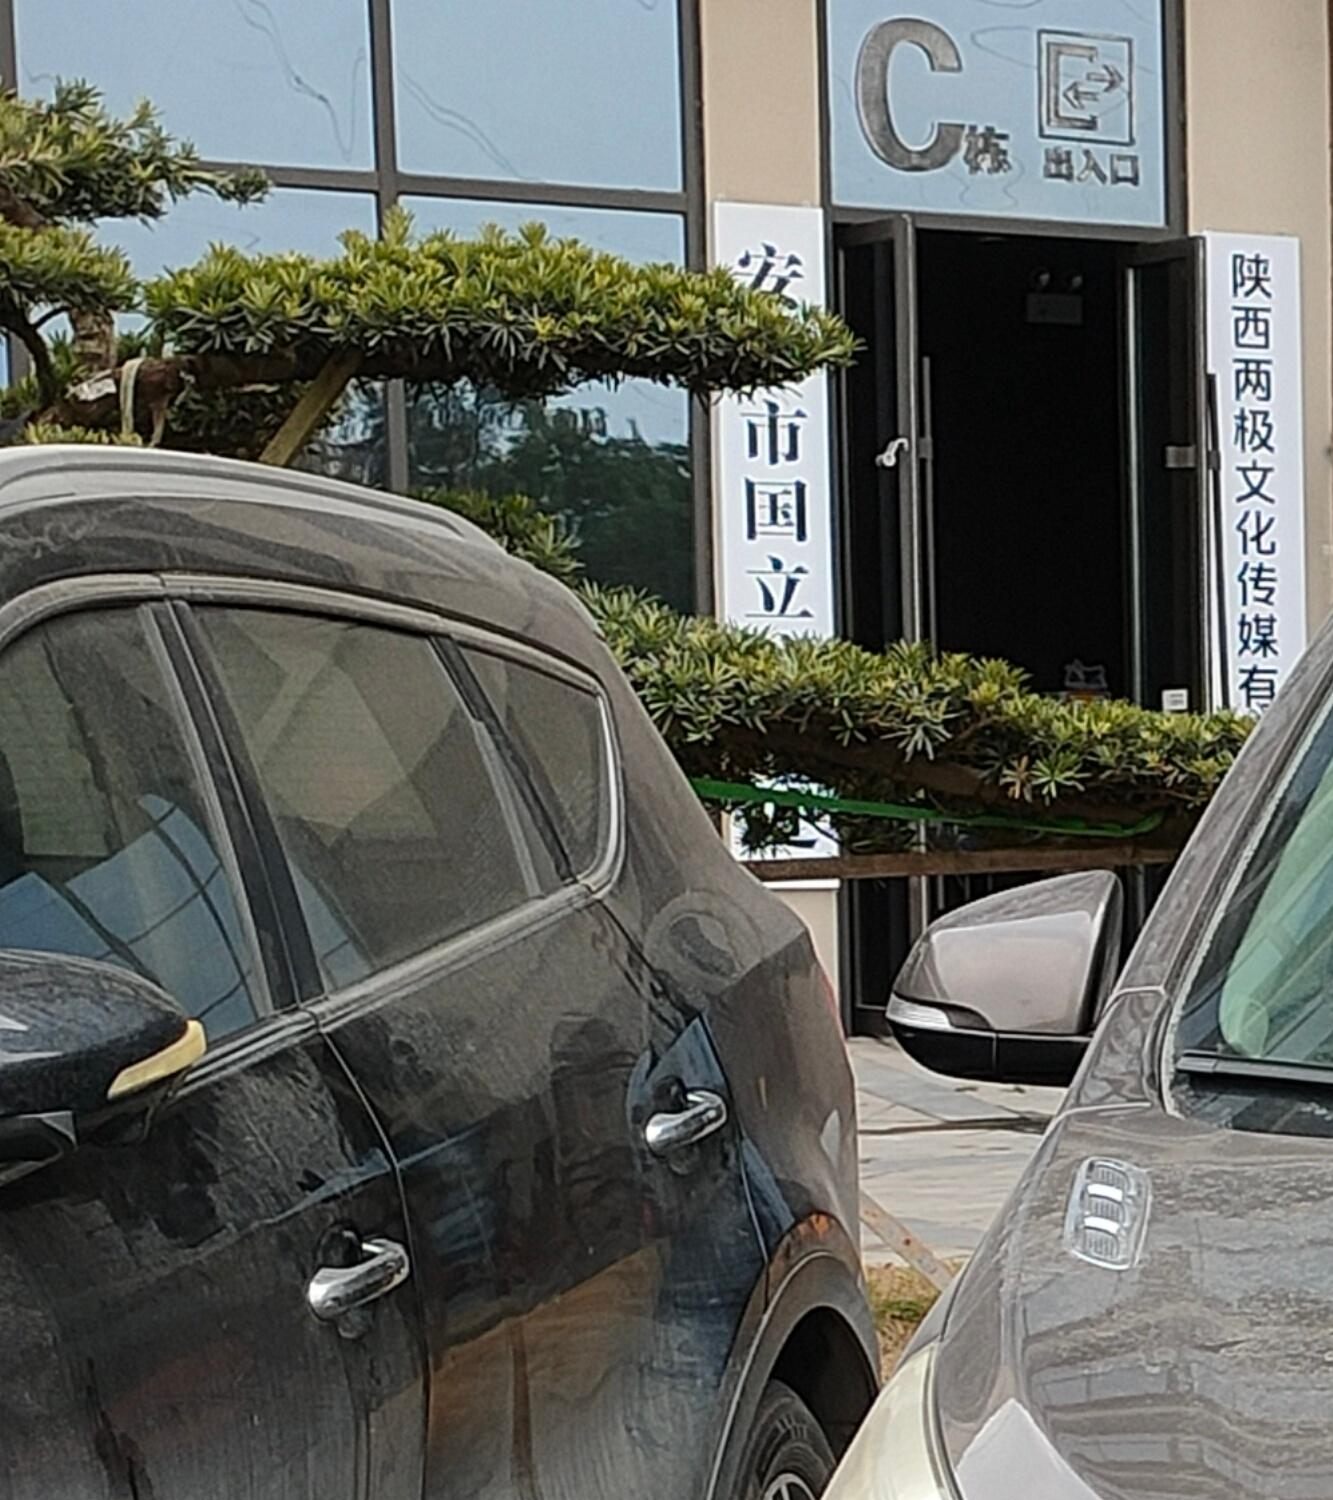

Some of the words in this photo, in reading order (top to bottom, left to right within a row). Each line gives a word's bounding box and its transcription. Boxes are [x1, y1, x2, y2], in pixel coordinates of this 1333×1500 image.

[1043, 147, 1139, 186] 出入口
[732, 240, 814, 619] 安市国立
